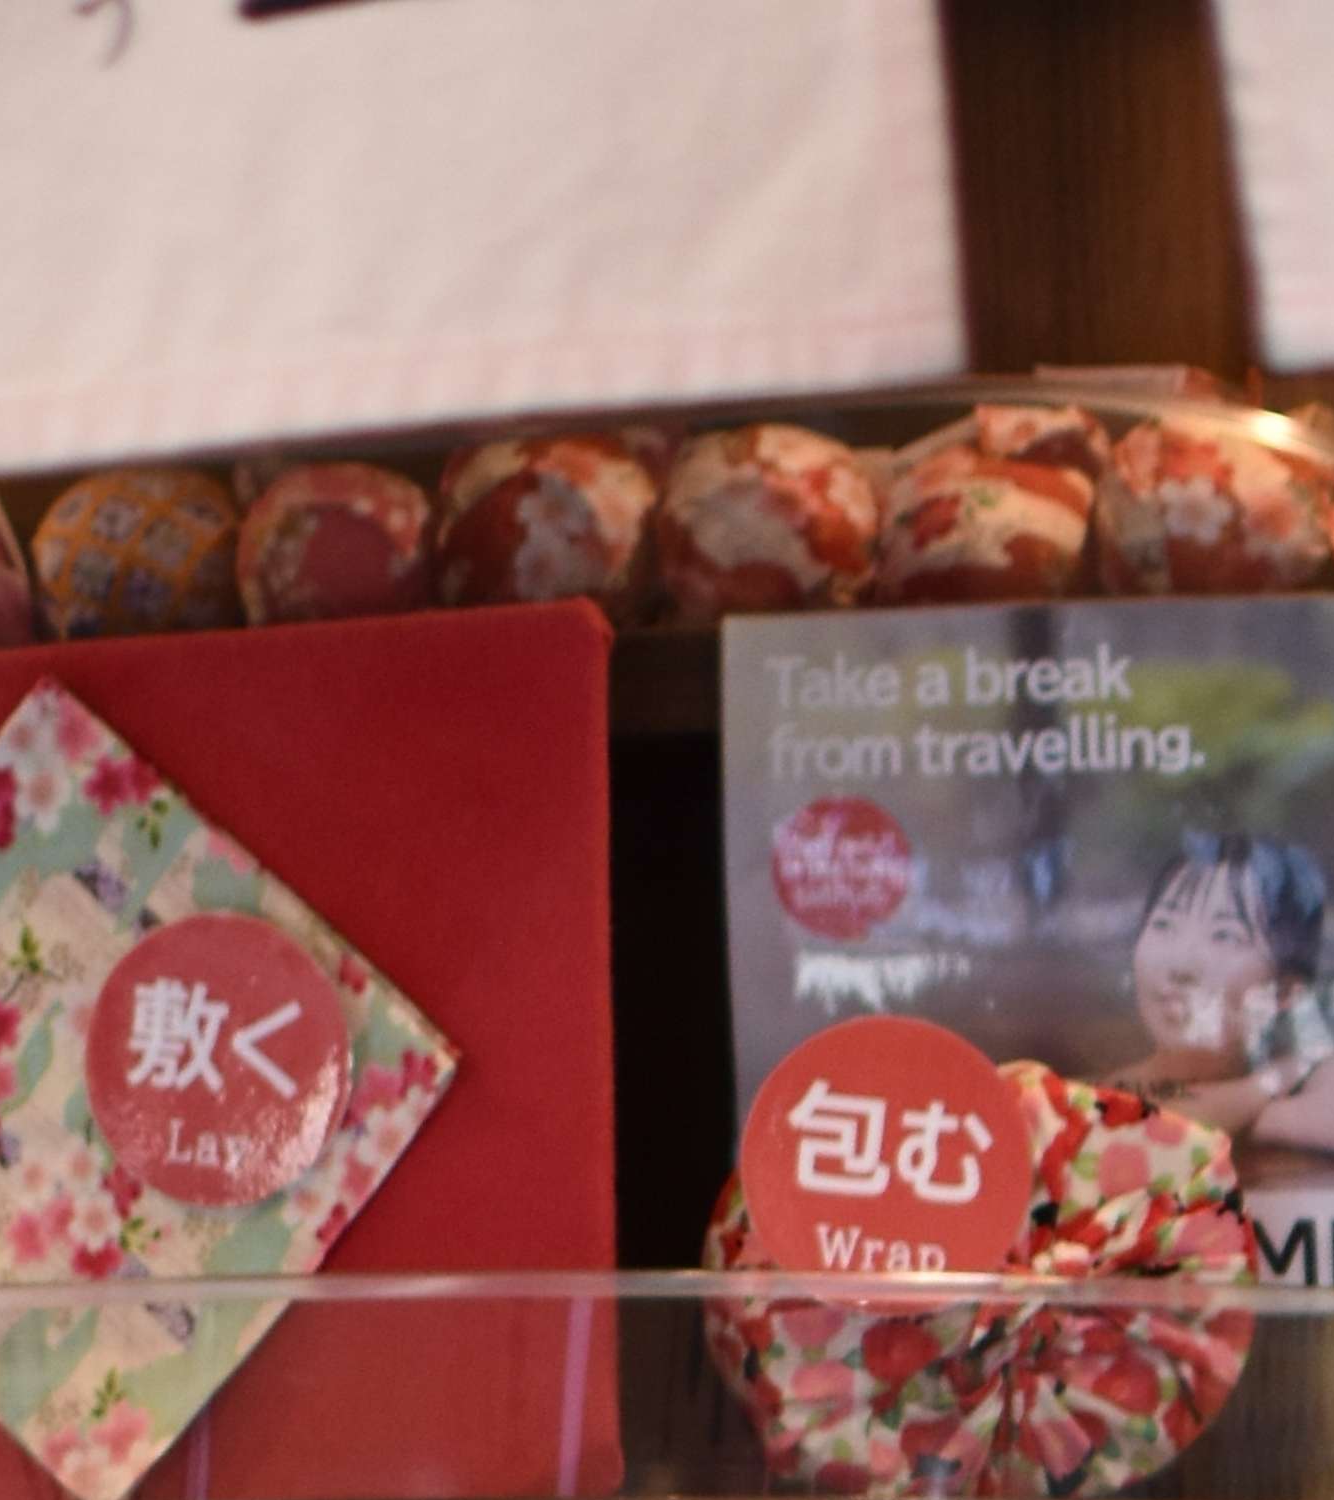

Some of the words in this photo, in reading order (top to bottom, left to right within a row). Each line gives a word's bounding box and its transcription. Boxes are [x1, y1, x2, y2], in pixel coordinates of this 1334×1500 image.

[767, 653, 903, 709] Take
[915, 658, 953, 707] a
[966, 642, 1134, 704] break
[768, 722, 903, 780] from
[915, 712, 1207, 775] travelling.
[126, 977, 304, 1099] 敷く
[788, 1077, 996, 1206] 包む
[814, 1222, 949, 1274] Wrap
